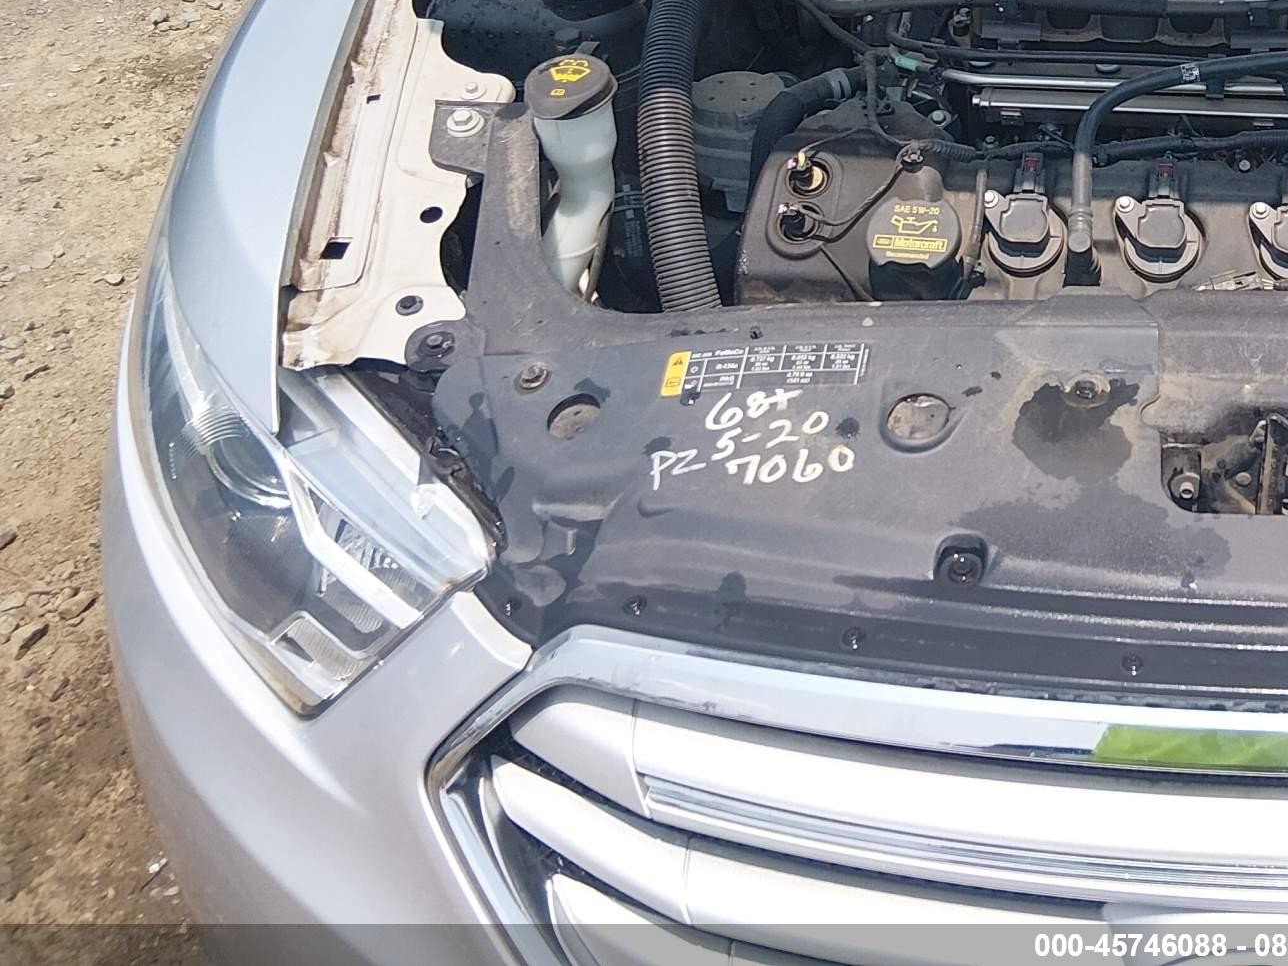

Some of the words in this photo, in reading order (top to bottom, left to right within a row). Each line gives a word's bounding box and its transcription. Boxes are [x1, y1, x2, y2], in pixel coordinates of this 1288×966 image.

[894, 204, 910, 213] SAE
[911, 206, 940, 215] 5W-20
[725, 445, 855, 484] 7060
